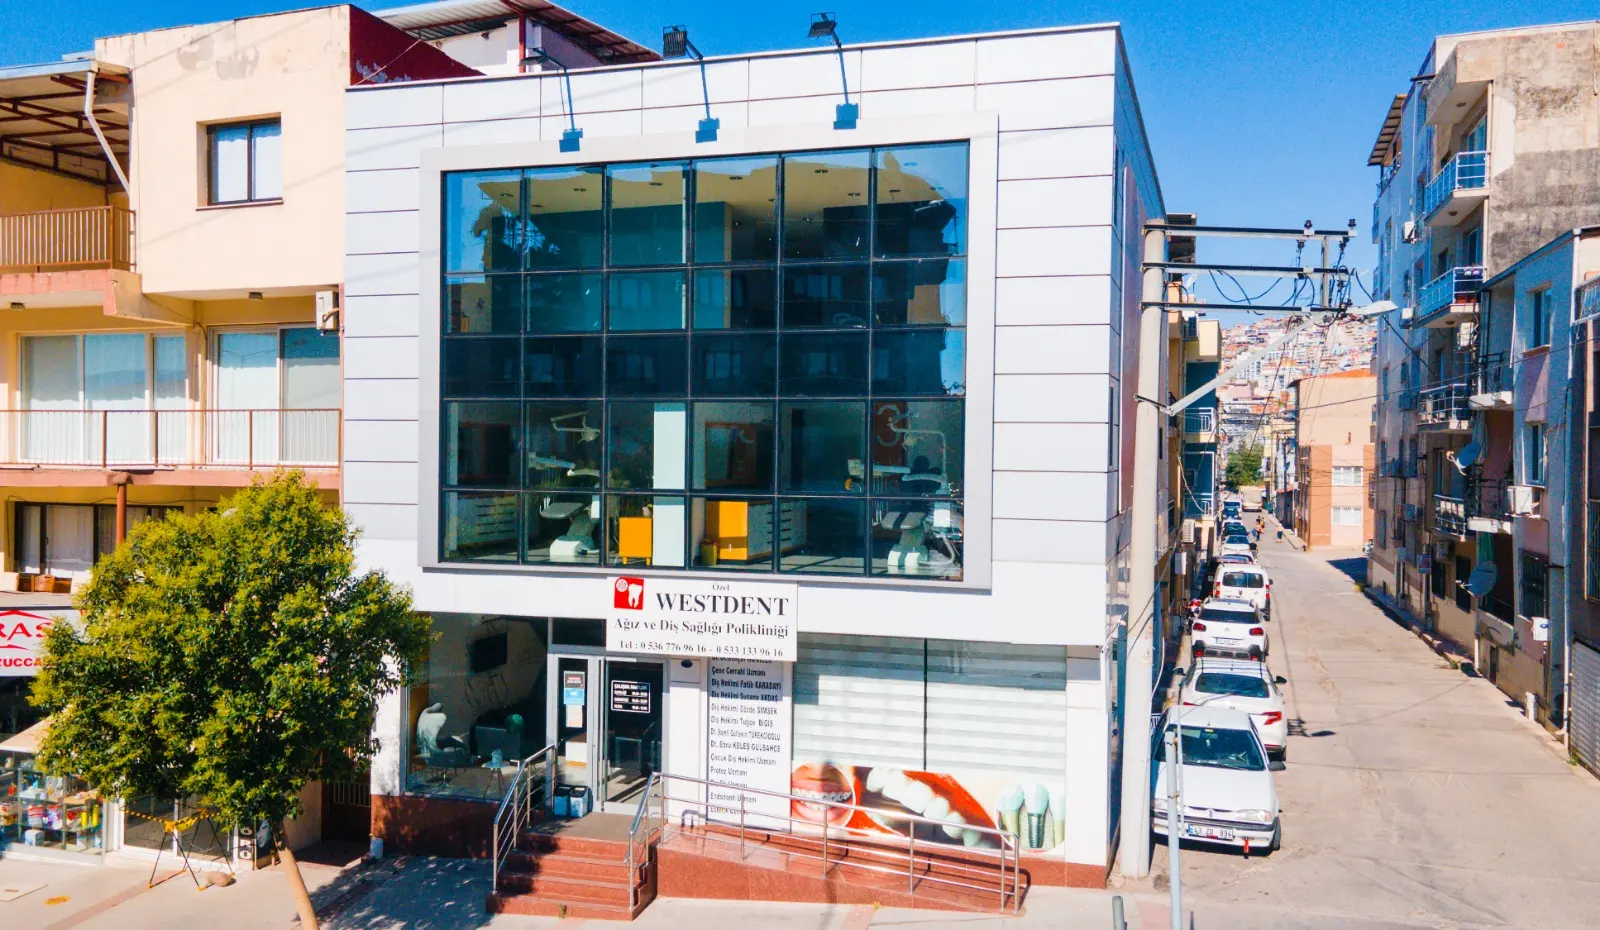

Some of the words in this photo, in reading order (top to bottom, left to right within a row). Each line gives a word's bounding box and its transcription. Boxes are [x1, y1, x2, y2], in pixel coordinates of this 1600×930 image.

[712, 581, 730, 591] Özel
[656, 592, 789, 616] WESTDENT
[614, 618, 640, 631] Ağız
[644, 621, 656, 630] ve
[660, 619, 679, 634] Diş
[682, 621, 722, 635] Sağlığı
[727, 622, 789, 639] Polikliniği
[620, 640, 632, 649] Tel
[648, 641, 663, 651] 536
[665, 642, 681, 651] 776
[683, 643, 694, 652] 96
[697, 644, 707, 652] 16
[760, 647, 770, 656] 96
[774, 648, 783, 657] 16
